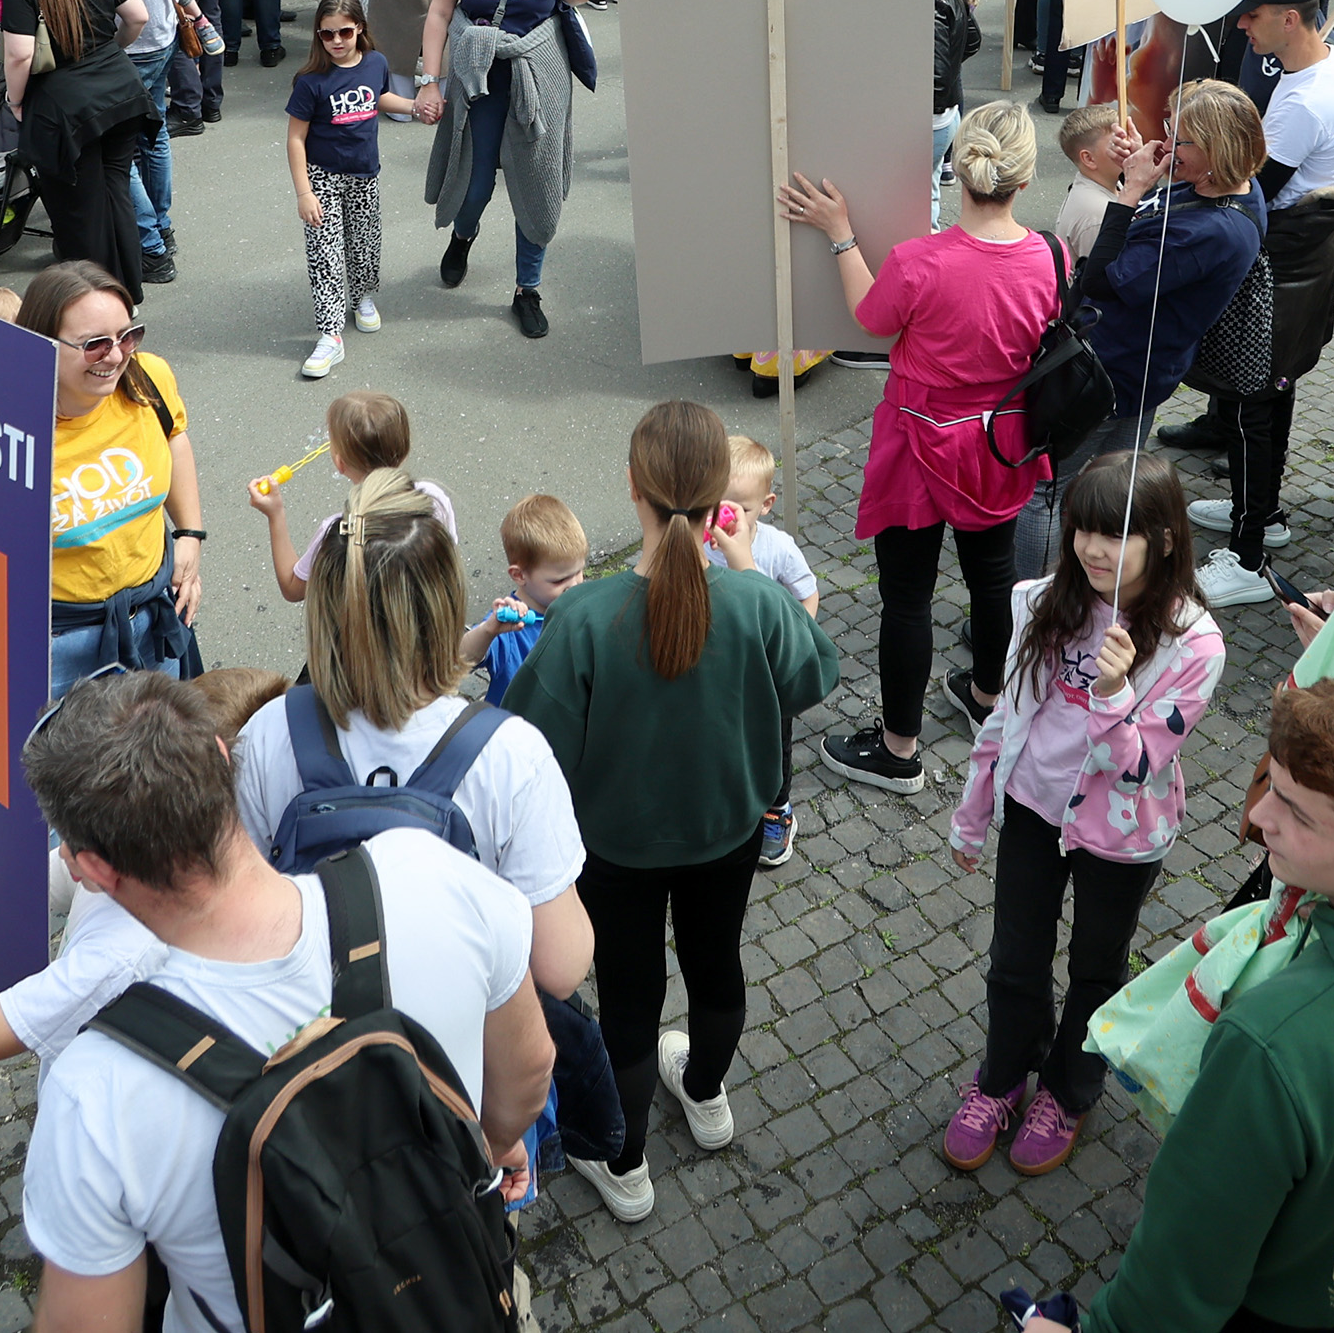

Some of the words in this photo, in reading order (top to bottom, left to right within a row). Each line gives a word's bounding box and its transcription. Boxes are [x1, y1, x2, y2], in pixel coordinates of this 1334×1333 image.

[329, 85, 375, 111] HOD
[331, 108, 347, 116] ZA
[348, 101, 377, 114] ŽIVOT
[51, 447, 144, 517] HOD
[51, 504, 89, 532] ZA
[92, 475, 154, 521] ŽIVOT
